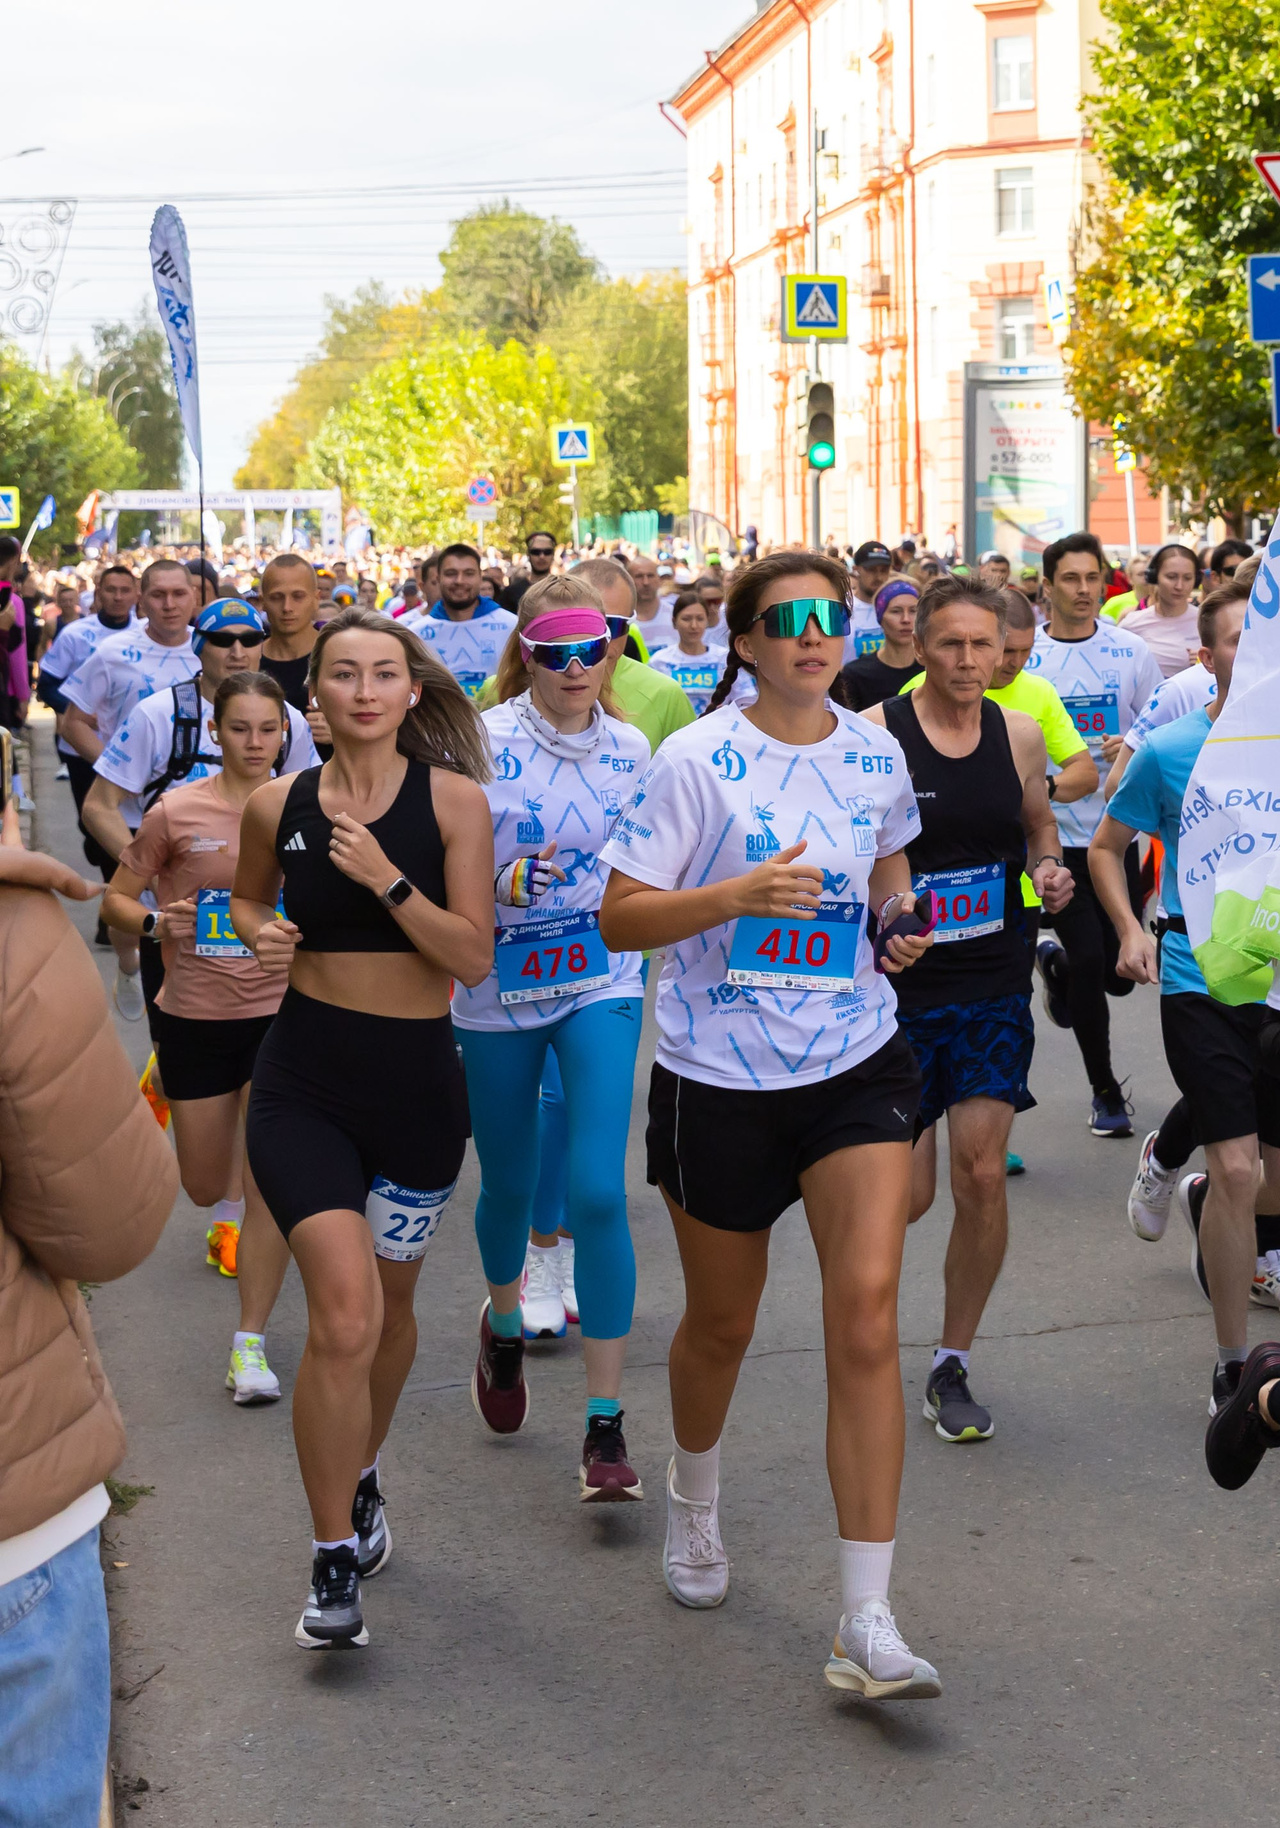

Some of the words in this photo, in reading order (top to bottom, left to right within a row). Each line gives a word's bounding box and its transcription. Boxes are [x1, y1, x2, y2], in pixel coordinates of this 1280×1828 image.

[612, 758, 636, 773] ВТБ
[861, 755, 894, 775] ВТБ
[932, 866, 987, 881] ДИНАМОВСКАЯ
[951, 876, 972, 885] МИЛЯ
[518, 917, 580, 934] ДИНАМОВСКАЯ
[539, 928, 564, 939] МИЛЯ
[755, 928, 831, 967] 410
[520, 943, 588, 981] 478
